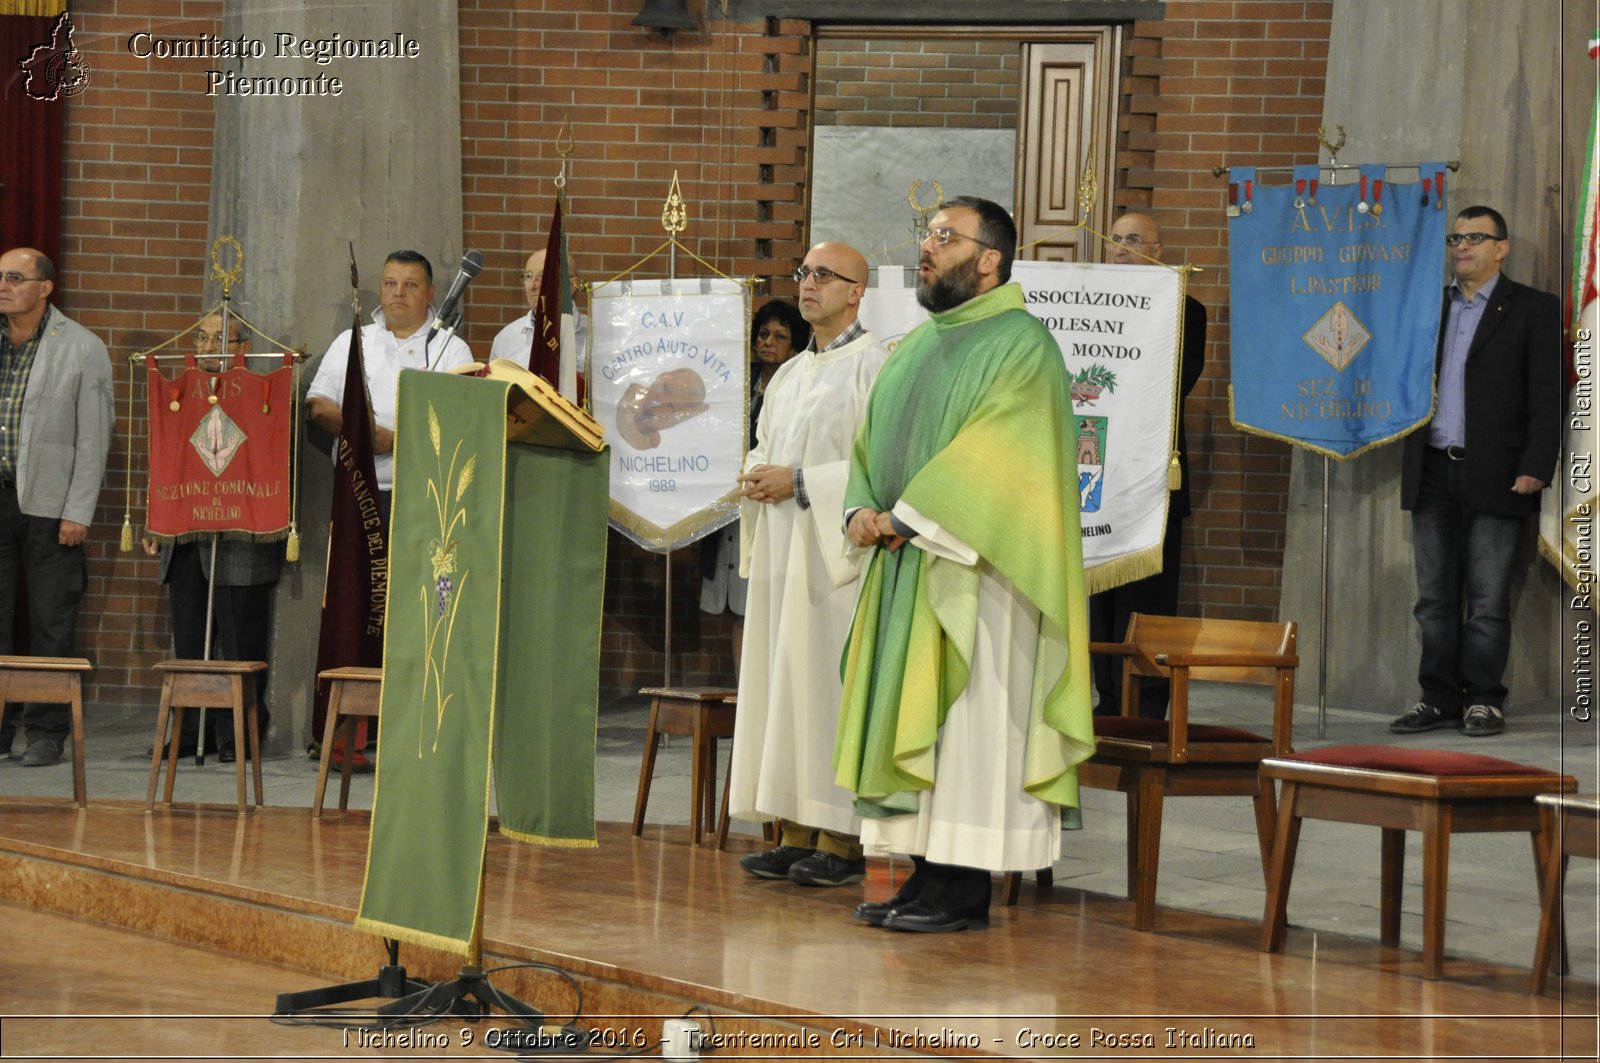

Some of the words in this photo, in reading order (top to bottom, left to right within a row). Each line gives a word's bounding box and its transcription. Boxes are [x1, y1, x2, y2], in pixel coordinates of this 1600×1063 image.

[1260, 246, 1323, 265] GRUPPO
[1338, 242, 1411, 264] GIOVANI
[1039, 316, 1125, 335] OLESANI
[601, 341, 653, 381] CENTRO
[656, 337, 699, 359] AIUTO
[703, 348, 732, 383] VITA
[1071, 342, 1142, 361] MONDO
[1280, 398, 1393, 421] NICHELINO
[619, 455, 709, 473] NICHELINO
[156, 480, 210, 501] SEZIONE
[214, 479, 281, 498] COMUNALE
[649, 479, 677, 493] 1989
[351, 469, 381, 530] SANGUE
[367, 532, 383, 556] DEL
[366, 557, 388, 637] PIEMONTE
